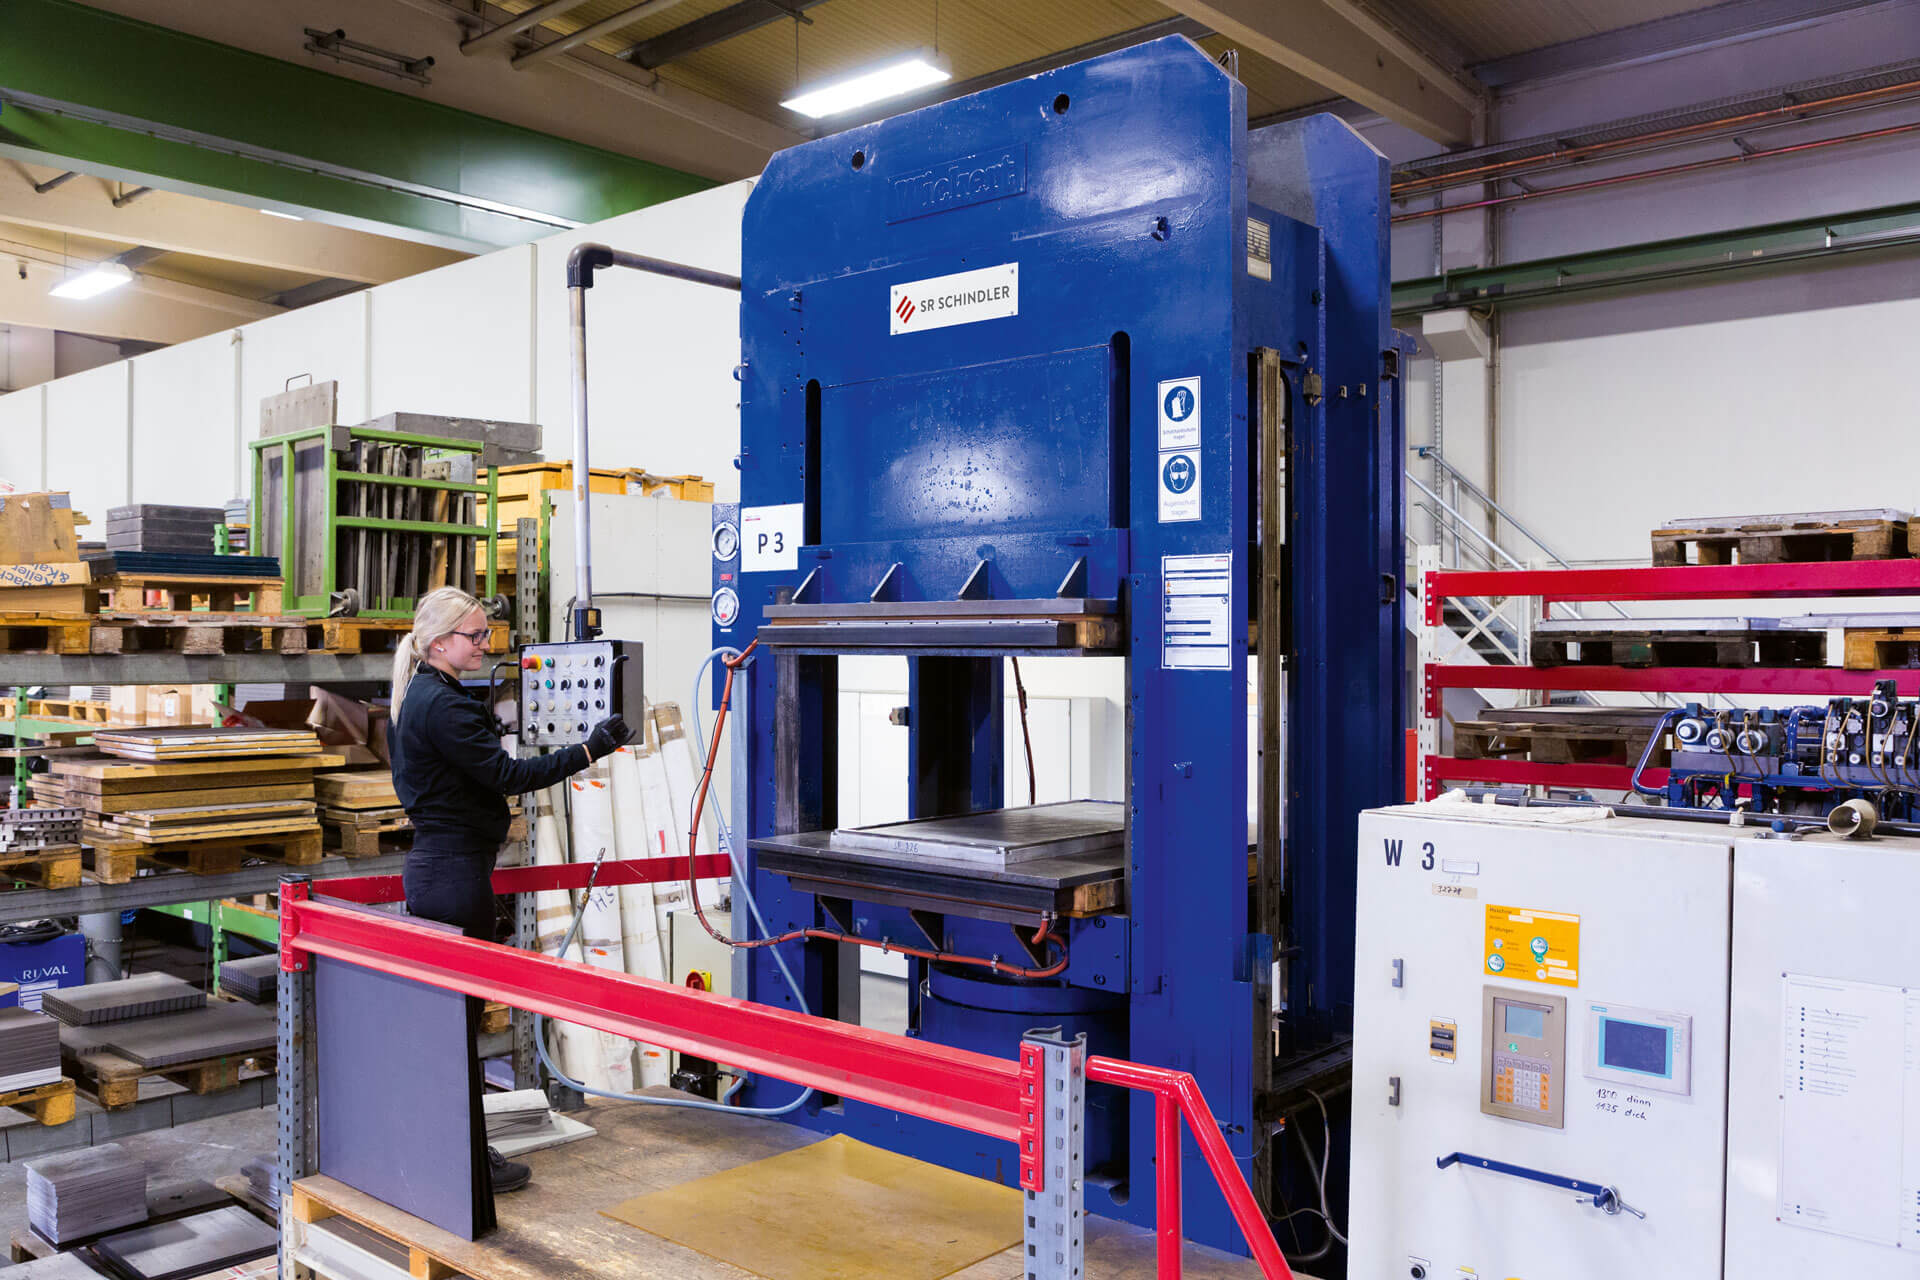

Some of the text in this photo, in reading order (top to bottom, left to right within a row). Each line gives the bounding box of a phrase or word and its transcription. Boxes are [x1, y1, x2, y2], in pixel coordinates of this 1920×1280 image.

[920, 285, 1010, 313] SR SCHINDLER
[758, 531, 784, 555] P 3
[60, 571, 70, 584] &
[1383, 838, 1435, 871] W 3
